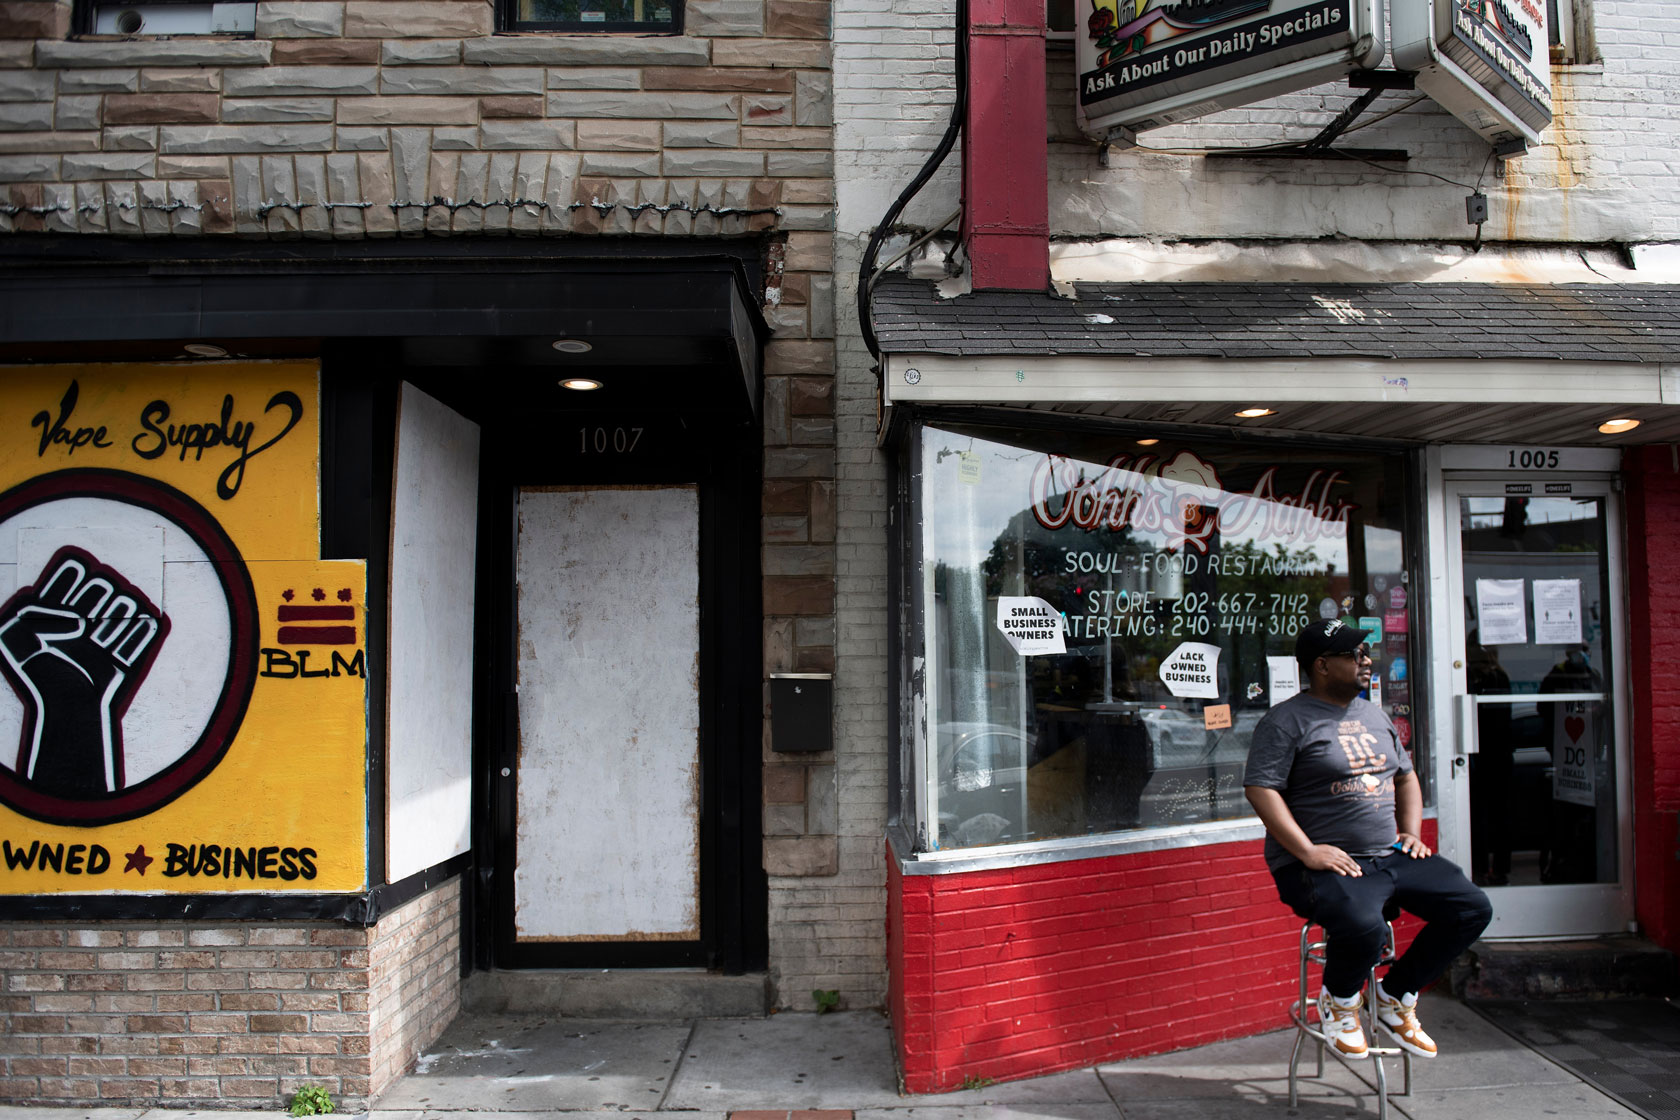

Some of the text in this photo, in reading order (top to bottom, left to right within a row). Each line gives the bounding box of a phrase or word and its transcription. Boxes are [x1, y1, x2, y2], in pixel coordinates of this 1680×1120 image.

[1085, 72, 1116, 95] Ask
[1119, 54, 1170, 85] About
[1174, 46, 1207, 67] Our
[1210, 31, 1257, 58] Daily
[1260, 7, 1342, 45] Specials
[31, 379, 304, 500] Vape Supply
[580, 427, 644, 453] 1007
[1508, 450, 1559, 468] 1005
[1065, 551, 1122, 574] SOUL
[1142, 553, 1198, 575] FOOD
[1011, 608, 1048, 617] SMALL
[1004, 619, 1056, 628] BUSINESS
[1062, 615, 1164, 638] ATERING:
[260, 648, 366, 679] BLM
[1180, 652, 1204, 662] LACK
[1170, 663, 1206, 672] OWNED
[1165, 673, 1211, 683] BUSINESS
[1338, 733, 1387, 768] DC
[1564, 747, 1585, 767] DC
[1562, 768, 1586, 780] SMALL
[1558, 778, 1592, 792] BUSINESS
[3, 840, 318, 880] WNED BUSINESS
